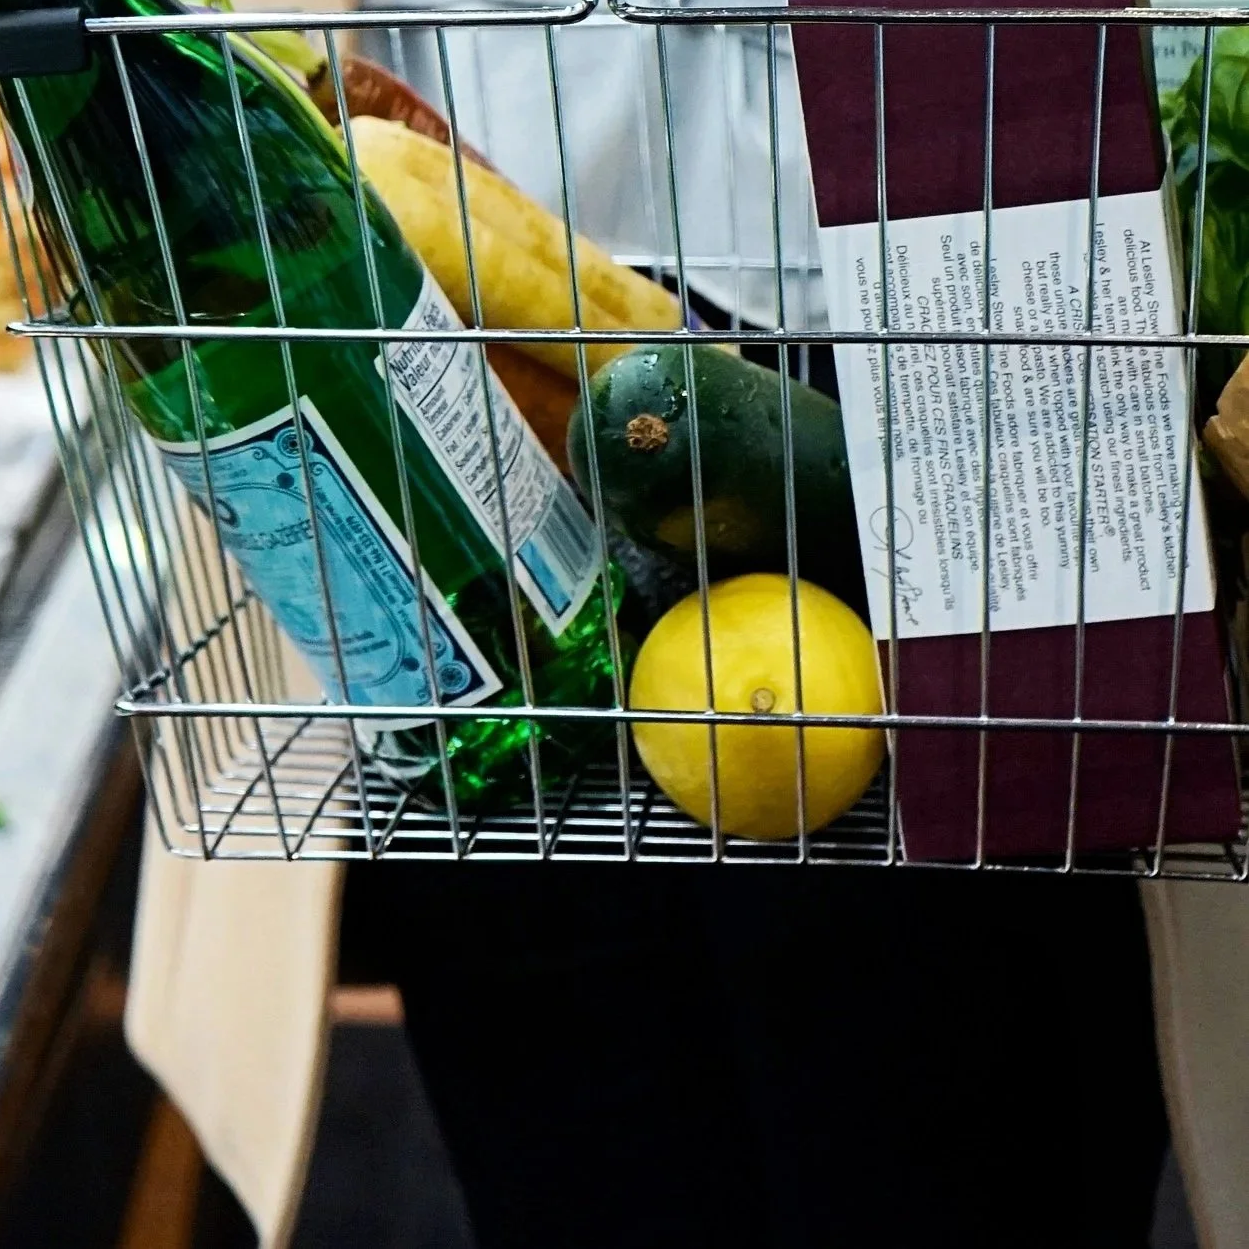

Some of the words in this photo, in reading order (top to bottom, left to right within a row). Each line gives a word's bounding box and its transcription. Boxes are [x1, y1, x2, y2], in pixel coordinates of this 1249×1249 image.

[939, 234, 954, 262] Seul
[969, 240, 981, 256] de
[1089, 222, 1108, 263] Lesley
[1122, 228, 1139, 282] delicious
[1139, 240, 1151, 253] At
[855, 257, 866, 286] vous
[895, 244, 914, 299] Délicieux
[944, 265, 954, 281] un
[956, 252, 968, 281] avec
[1035, 259, 1048, 279] but
[1049, 251, 1064, 285] these
[1099, 266, 1110, 275] &
[1138, 257, 1157, 297] Lesley
[859, 289, 869, 304] ne
[1021, 260, 1037, 305] cheese
[1068, 284, 1078, 293] A
[1100, 279, 1113, 299] her
[883, 268, 904, 352] accompags
[903, 303, 913, 319] au
[944, 284, 961, 325] produit
[1037, 282, 1053, 314] really
[1052, 288, 1069, 330] unique
[1117, 295, 1128, 316] are
[1130, 286, 1144, 315] food.
[916, 295, 936, 362] CRAEZ
[965, 317, 974, 332] en
[991, 300, 1006, 332] Stow
[1012, 305, 1025, 333] snac
[1027, 308, 1037, 320] or
[1069, 298, 1085, 338] CRIS
[1104, 303, 1117, 333] team
[859, 307, 877, 354] pouz
[905, 322, 921, 366] nurel,
[1043, 318, 1057, 351] she
[1091, 324, 1105, 351] frm
[1120, 319, 1133, 353] me
[1135, 318, 1149, 356] The
[896, 355, 908, 371] de
[953, 329, 968, 373] aison
[969, 346, 983, 375] etites
[1027, 324, 1045, 381] apasto.
[1060, 333, 1077, 384] ackers
[866, 356, 882, 382] plus
[913, 370, 923, 391] ces
[938, 344, 955, 388] pouvait
[1023, 374, 1033, 382] &
[1048, 354, 1061, 386] when
[1096, 354, 1112, 398] scratch
[1113, 370, 1125, 390] the
[1126, 357, 1139, 381] with
[925, 364, 942, 404] POUR
[1001, 372, 1016, 409] Foods
[1024, 387, 1034, 406] are
[1037, 384, 1051, 405] We
[1067, 387, 1077, 407] are
[1129, 384, 1140, 411] care
[1140, 359, 1157, 410] fabulous
[1156, 372, 1171, 410] Foods
[872, 385, 885, 413] vous
[897, 374, 916, 434] trempette,
[956, 375, 975, 425] fabriqué
[1051, 389, 1068, 431] topped
[1113, 392, 1129, 418] only
[914, 394, 934, 456] craquelins
[932, 407, 945, 435] CES
[946, 390, 964, 445] satisfaire
[990, 397, 1007, 448] fabuleux
[1006, 412, 1020, 447] adore
[1027, 410, 1039, 436] sure
[1041, 408, 1052, 428] are
[1100, 402, 1116, 434] using
[1133, 415, 1144, 426] in
[1145, 413, 1161, 450] crisps
[1162, 414, 1171, 431] we
[907, 437, 919, 453] de
[966, 429, 977, 456] avec
[1058, 434, 1072, 459] with
[1107, 437, 1117, 456] our
[1117, 421, 1130, 446] way
[1135, 429, 1149, 461] small
[1164, 435, 1177, 460] love
[937, 438, 950, 469] FINS
[1028, 440, 1041, 462] you
[1044, 431, 1061, 483] addicted
[1124, 448, 1134, 460] to
[908, 456, 927, 506] fromage
[924, 459, 939, 485] sont
[953, 448, 969, 487] Lesley
[970, 460, 982, 481] des
[1008, 450, 1028, 504] fabriquer
[1034, 465, 1046, 484] will
[1060, 462, 1074, 488] your
[1110, 460, 1123, 492] finest
[1125, 463, 1139, 497] make
[1153, 453, 1165, 480] from
[960, 490, 971, 501] et
[996, 451, 1016, 513] craquelins
[1037, 487, 1048, 503] be
[1051, 485, 1062, 498] to
[1140, 465, 1155, 514] batches.
[1165, 463, 1183, 507] making
[917, 508, 927, 524] ou
[941, 472, 963, 560] CRAQUELINS
[963, 505, 973, 526] son
[988, 487, 1004, 529] cuisine
[1019, 507, 1030, 519] et
[1053, 500, 1066, 522] this
[1129, 500, 1137, 508] a
[1154, 484, 1172, 532] Lesley's
[929, 488, 949, 555] irrésistibles
[1006, 516, 1020, 542] sont
[1111, 495, 1133, 562] ingredients.
[1128, 510, 1145, 543] great
[994, 532, 1007, 548] de
[1021, 522, 1033, 551] vous
[1054, 525, 1069, 569] yummy
[963, 530, 980, 574] équipe.
[1088, 547, 1099, 573] own
[1163, 535, 1178, 578] kitchen
[1008, 545, 1028, 601] fabriqués
[1026, 553, 1039, 582] offrir
[1133, 545, 1150, 591] product
